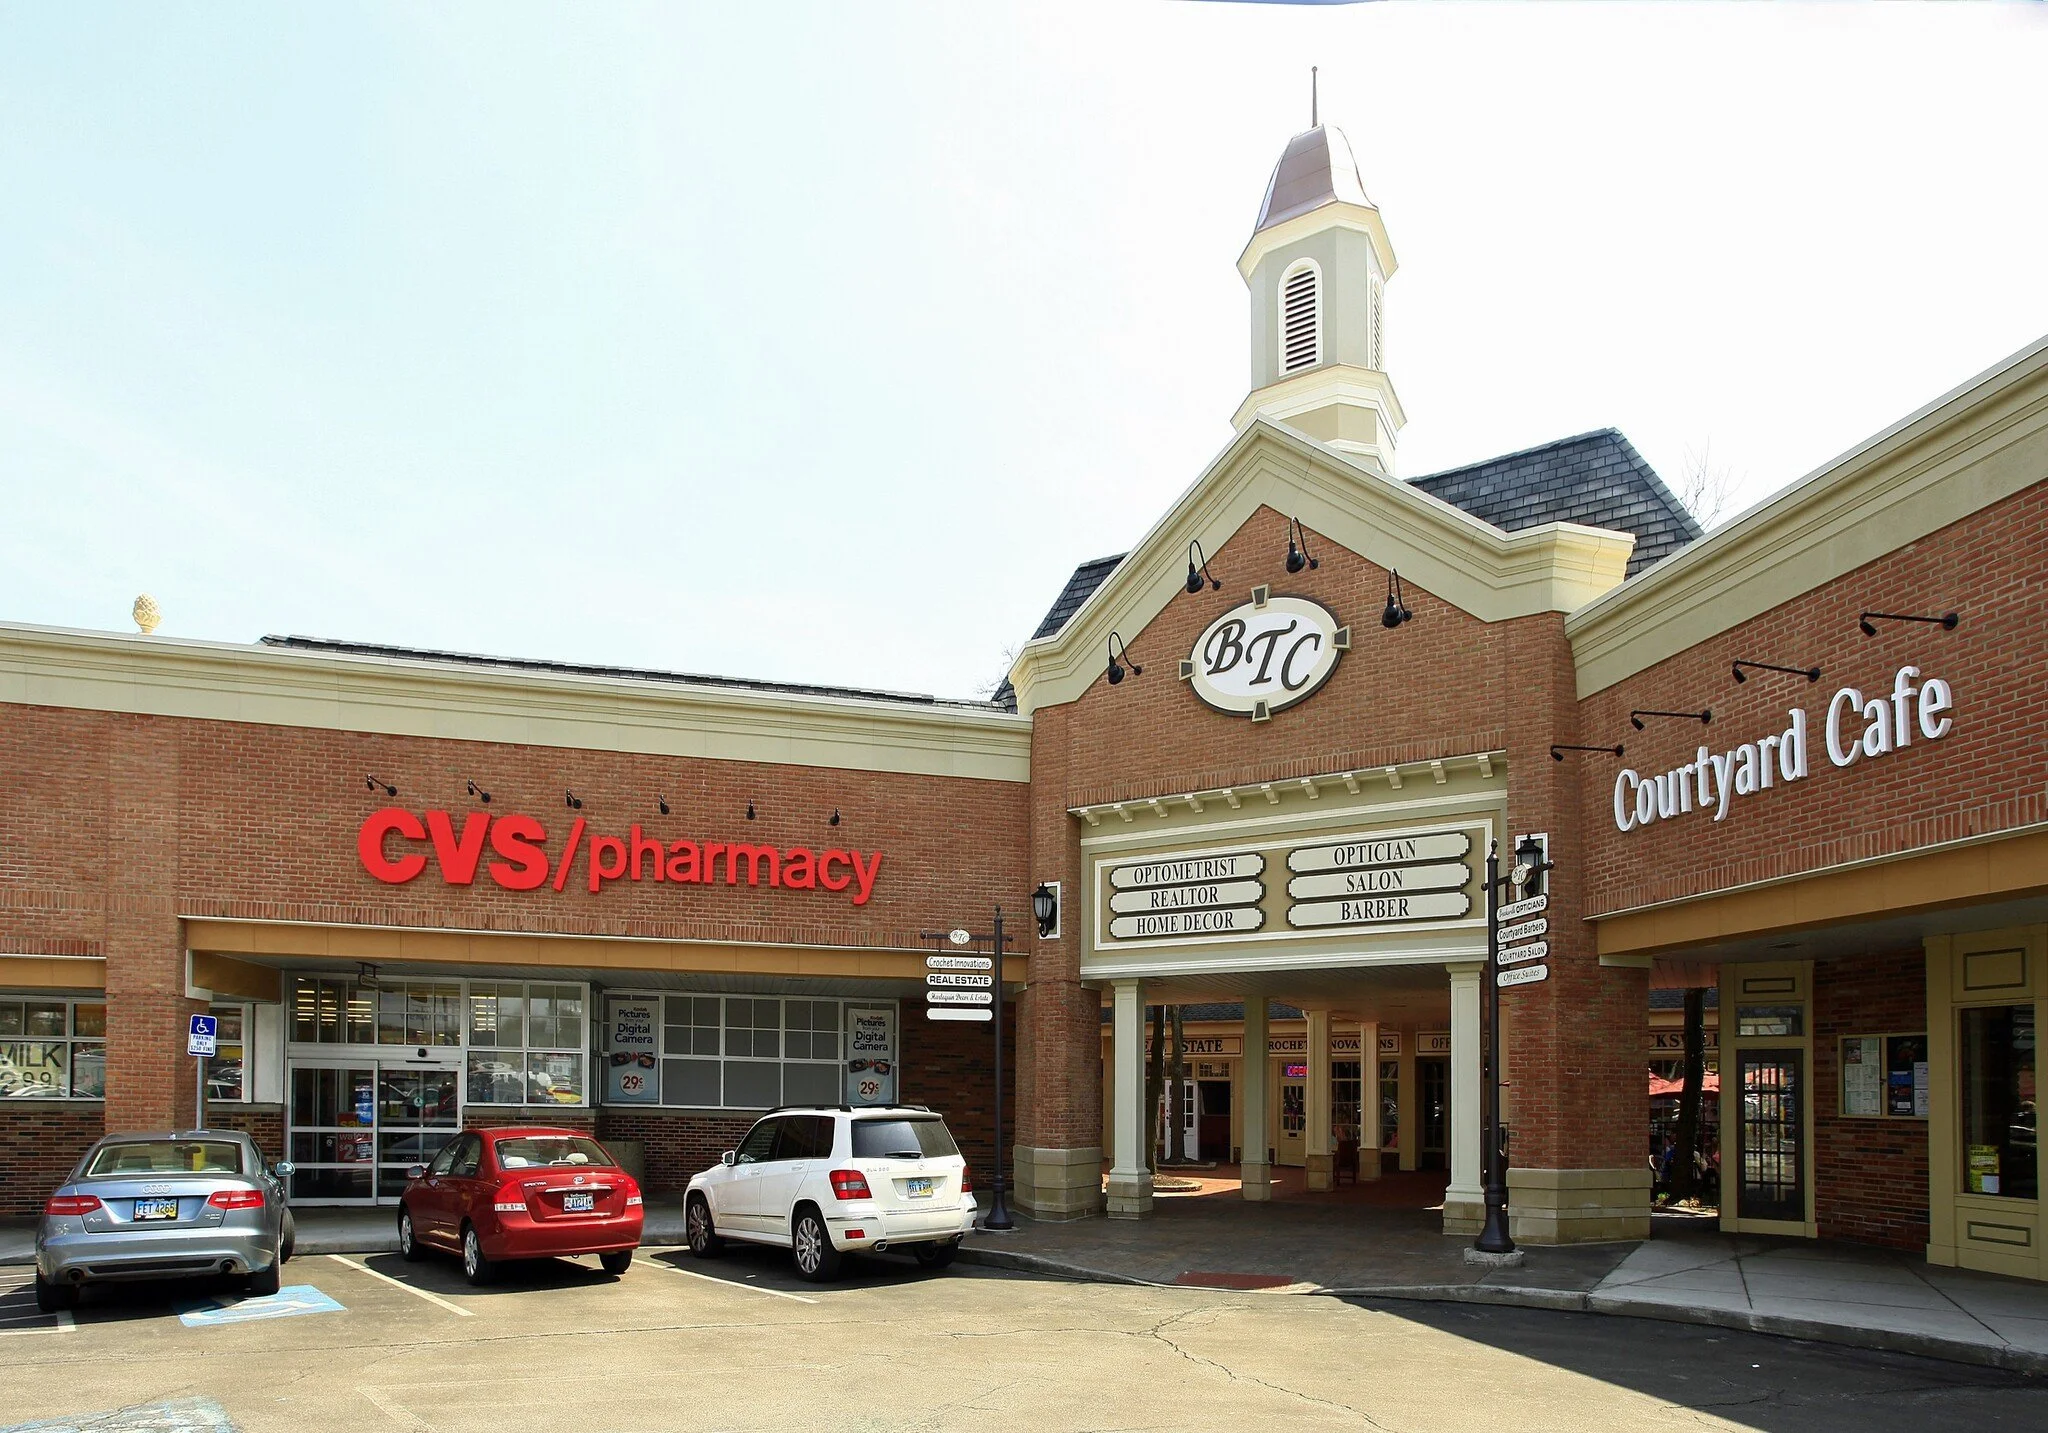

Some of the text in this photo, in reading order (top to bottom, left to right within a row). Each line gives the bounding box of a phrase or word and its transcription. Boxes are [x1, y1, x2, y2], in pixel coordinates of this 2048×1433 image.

[1203, 619, 1322, 691] BTC
[1613, 665, 1953, 832] Courtyard Cafe
[1334, 840, 1417, 866] OPTICIAN
[1133, 858, 1238, 885] OPTOMETRIST
[1345, 870, 1404, 892] SALON
[1150, 886, 1219, 908] REALTOR
[1340, 899, 1410, 921] BARBER
[1516, 898, 1545, 913] OPTICIANS
[1136, 911, 1235, 934] HOME DECOR
[1498, 921, 1545, 940] Courtyard Barbers
[1498, 946, 1545, 962] COURTYARD SALON
[928, 957, 990, 968] Crochet Innovations
[929, 975, 989, 985] REAL ESTATE
[1503, 972, 1521, 983] Office
[618, 1009, 651, 1019] Pictures
[617, 1023, 651, 1035] Digital
[856, 1018, 886, 1027] Pictures
[614, 1033, 653, 1044] Camera
[855, 1031, 886, 1043] Digital
[852, 1040, 889, 1051] Camera
[1182, 1040, 1224, 1052] STATE
[137, 1202, 175, 1214] FET 4265
